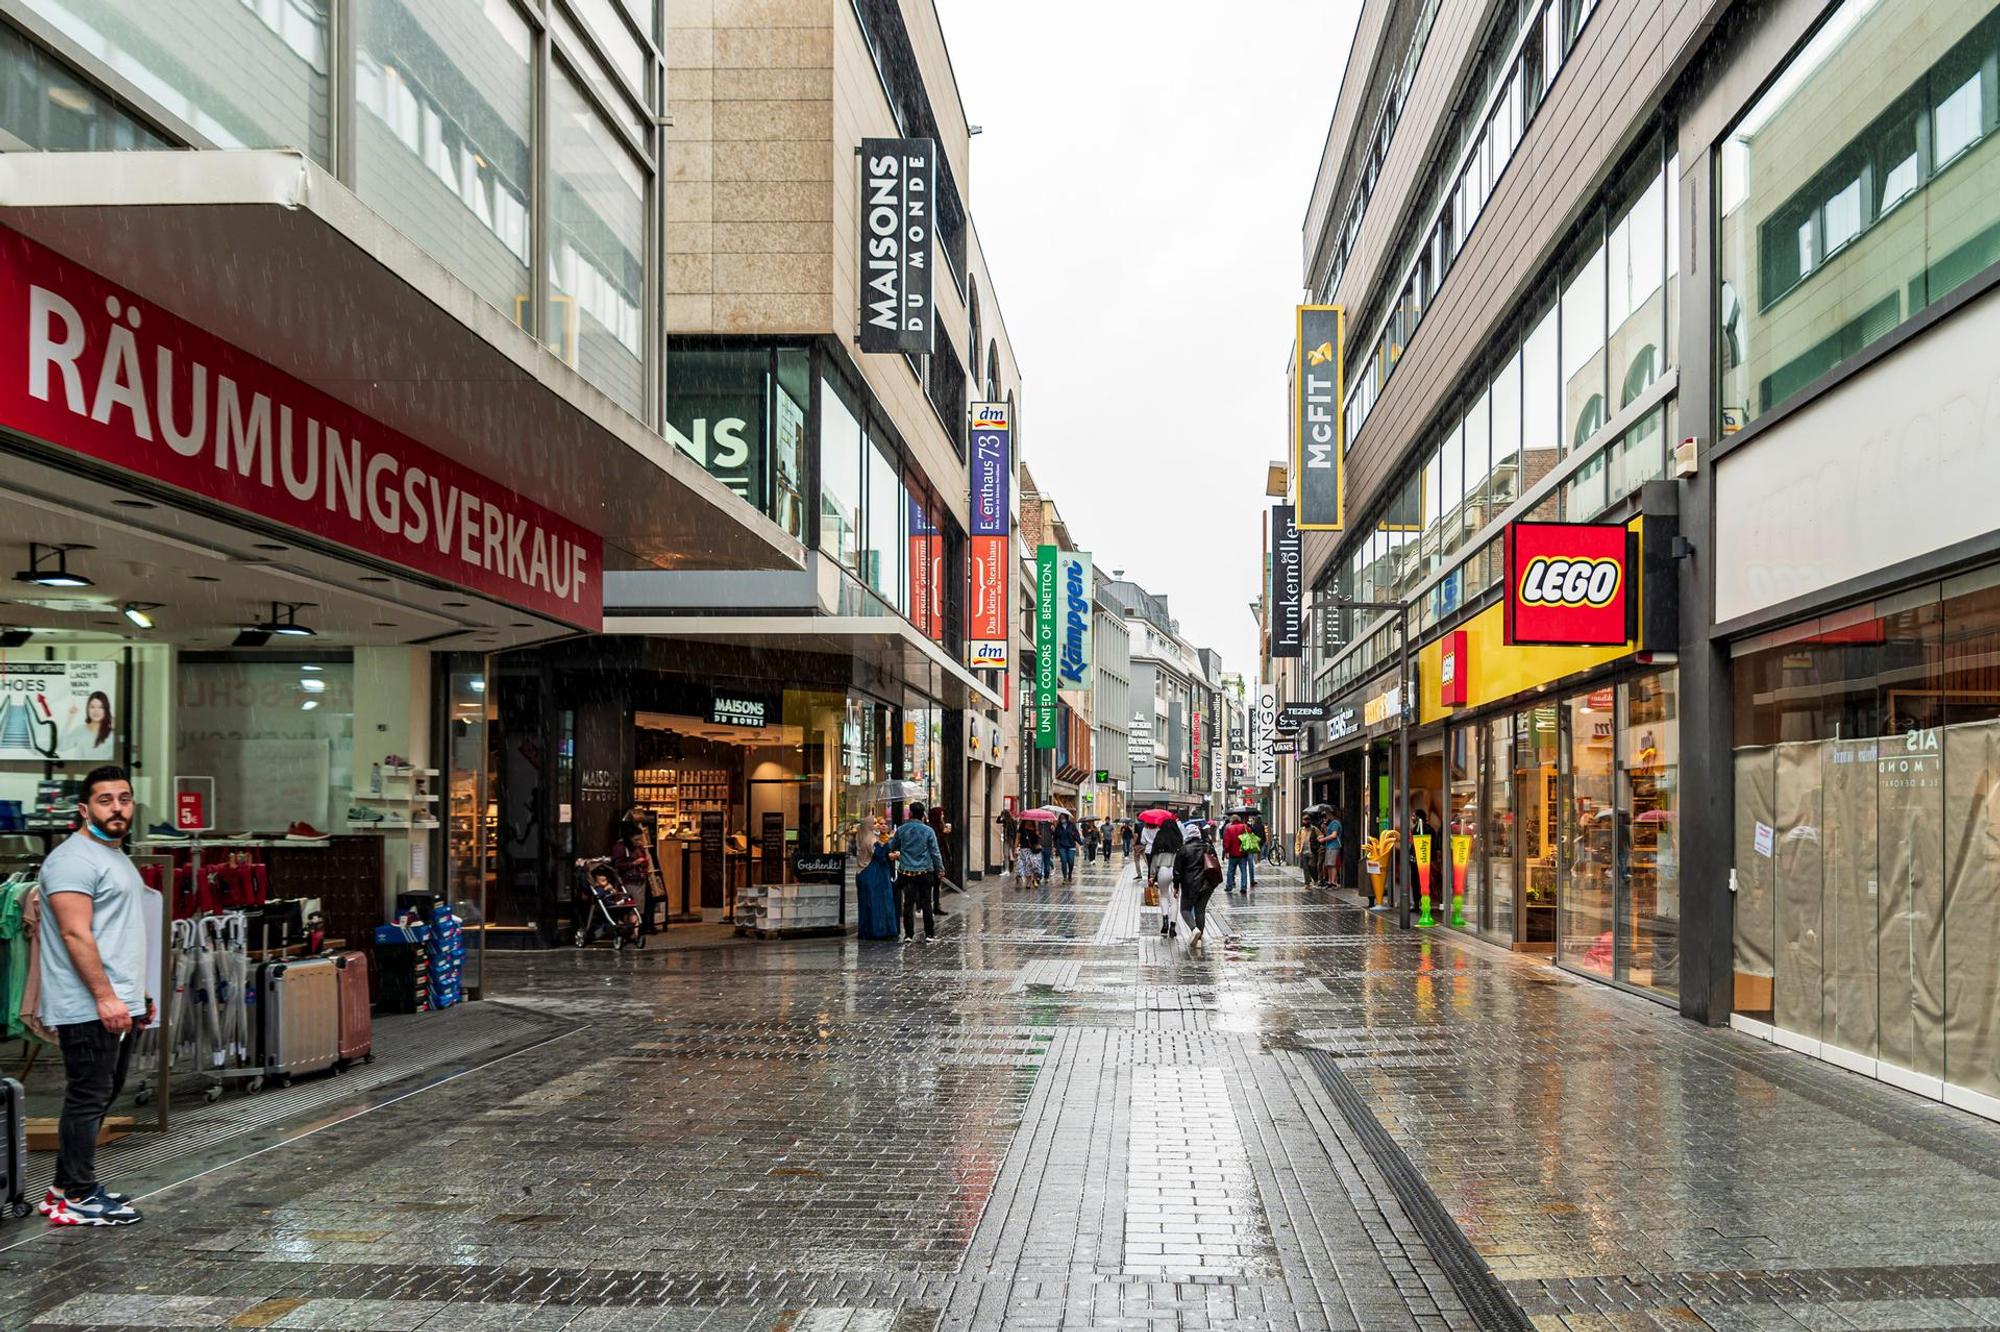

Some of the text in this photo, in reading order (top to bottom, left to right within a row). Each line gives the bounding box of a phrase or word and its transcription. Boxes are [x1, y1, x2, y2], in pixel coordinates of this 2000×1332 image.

[869, 155, 898, 330] MAISONS
[909, 156, 925, 331] DU MONDE
[980, 407, 1003, 420] dm
[28, 285, 588, 603] RÄUMUNGSVERKAUF
[978, 435, 1000, 530] Eventhaus 73
[985, 540, 996, 635] Das kleine Steakhaus
[1279, 518, 1298, 645] hunkemöller
[1524, 560, 1615, 602] LEGO
[1041, 619, 1051, 635] OF
[1060, 560, 1088, 684] Kämpgen
[978, 644, 1002, 657] dm
[1041, 639, 1051, 683] COLORS
[0, 679, 46, 692] HOES
[714, 698, 765, 716] MAISONS
[714, 715, 764, 727] DU MONDE
[1041, 687, 1051, 733] UNITED
[1262, 694, 1274, 774] MANGO
